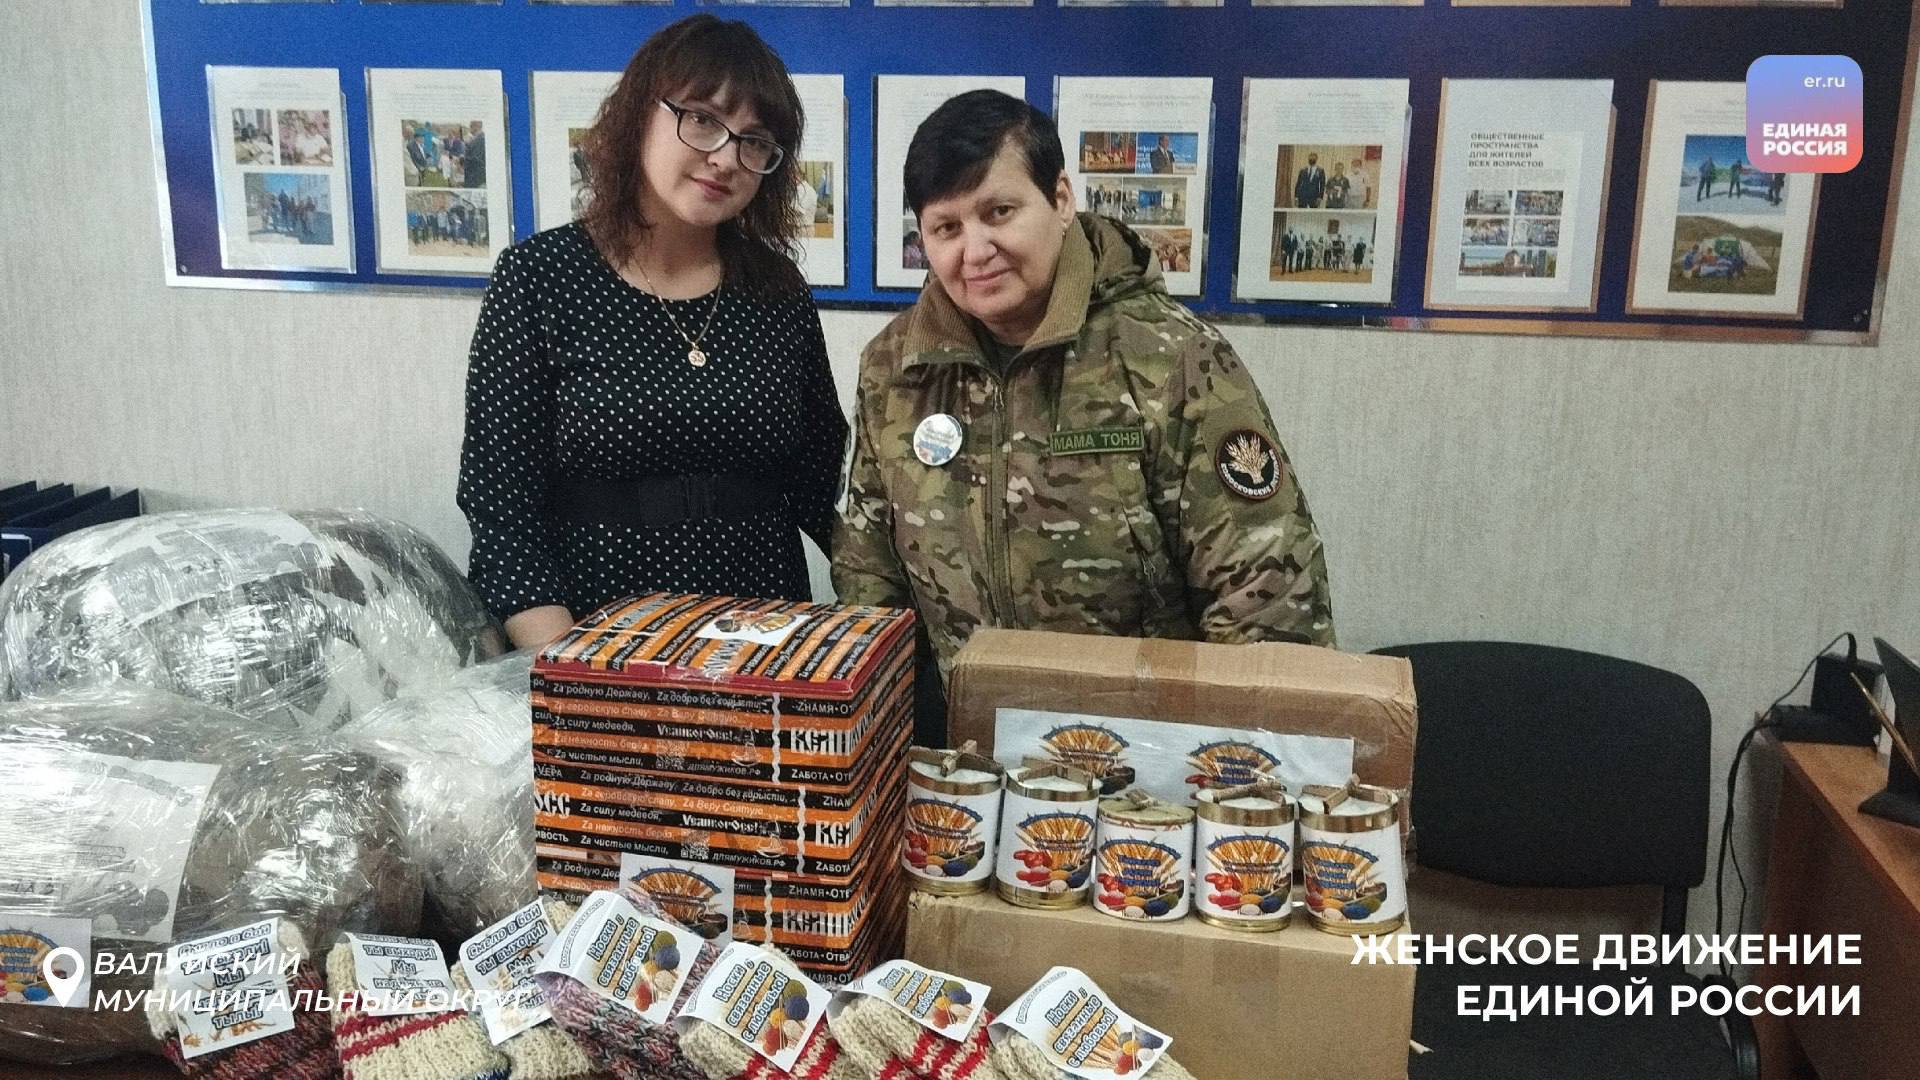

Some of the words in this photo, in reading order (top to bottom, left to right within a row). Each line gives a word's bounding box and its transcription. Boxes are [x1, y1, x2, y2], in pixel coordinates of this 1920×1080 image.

[1470, 132, 1544, 141] ОБЩЕСТВЕННЫЕ
[1470, 141, 1539, 149] ПРОСТРАНСТВА
[1468, 160, 1490, 168] ВСЕХ
[1493, 160, 1544, 168] ВОЗРАСТОВ
[1469, 151, 1488, 159] ДЛЯ
[1490, 150, 1532, 159] ЖИТЕЛЕЙ
[1054, 434, 1096, 451] МАМА
[1101, 431, 1140, 448] ТОНЯ
[566, 684, 604, 696] родную
[605, 687, 650, 700] Державу,
[670, 692, 698, 704] добро
[567, 719, 590, 730] силу
[592, 721, 636, 733] медведя,
[569, 751, 608, 762] чистые
[609, 755, 644, 767] мысли,
[594, 772, 631, 785] родную
[696, 783, 723, 796] добро
[725, 787, 741, 798] без
[593, 806, 618, 817] силу
[619, 808, 661, 821] медведя,
[697, 799, 720, 812] Веру
[594, 838, 632, 851] чистые
[634, 842, 669, 855] мысли,
[564, 862, 600, 876] родную
[467, 928, 508, 961] Смело
[515, 903, 543, 928] бой
[475, 953, 499, 976] ты
[495, 919, 548, 963] выходи!
[597, 916, 640, 988] связанные
[620, 925, 658, 996] любовью!
[726, 961, 773, 1028] связанные
[749, 970, 790, 1036] любовью!
[1052, 994, 1103, 1054] связанные
[1074, 1006, 1119, 1064] любовью!
